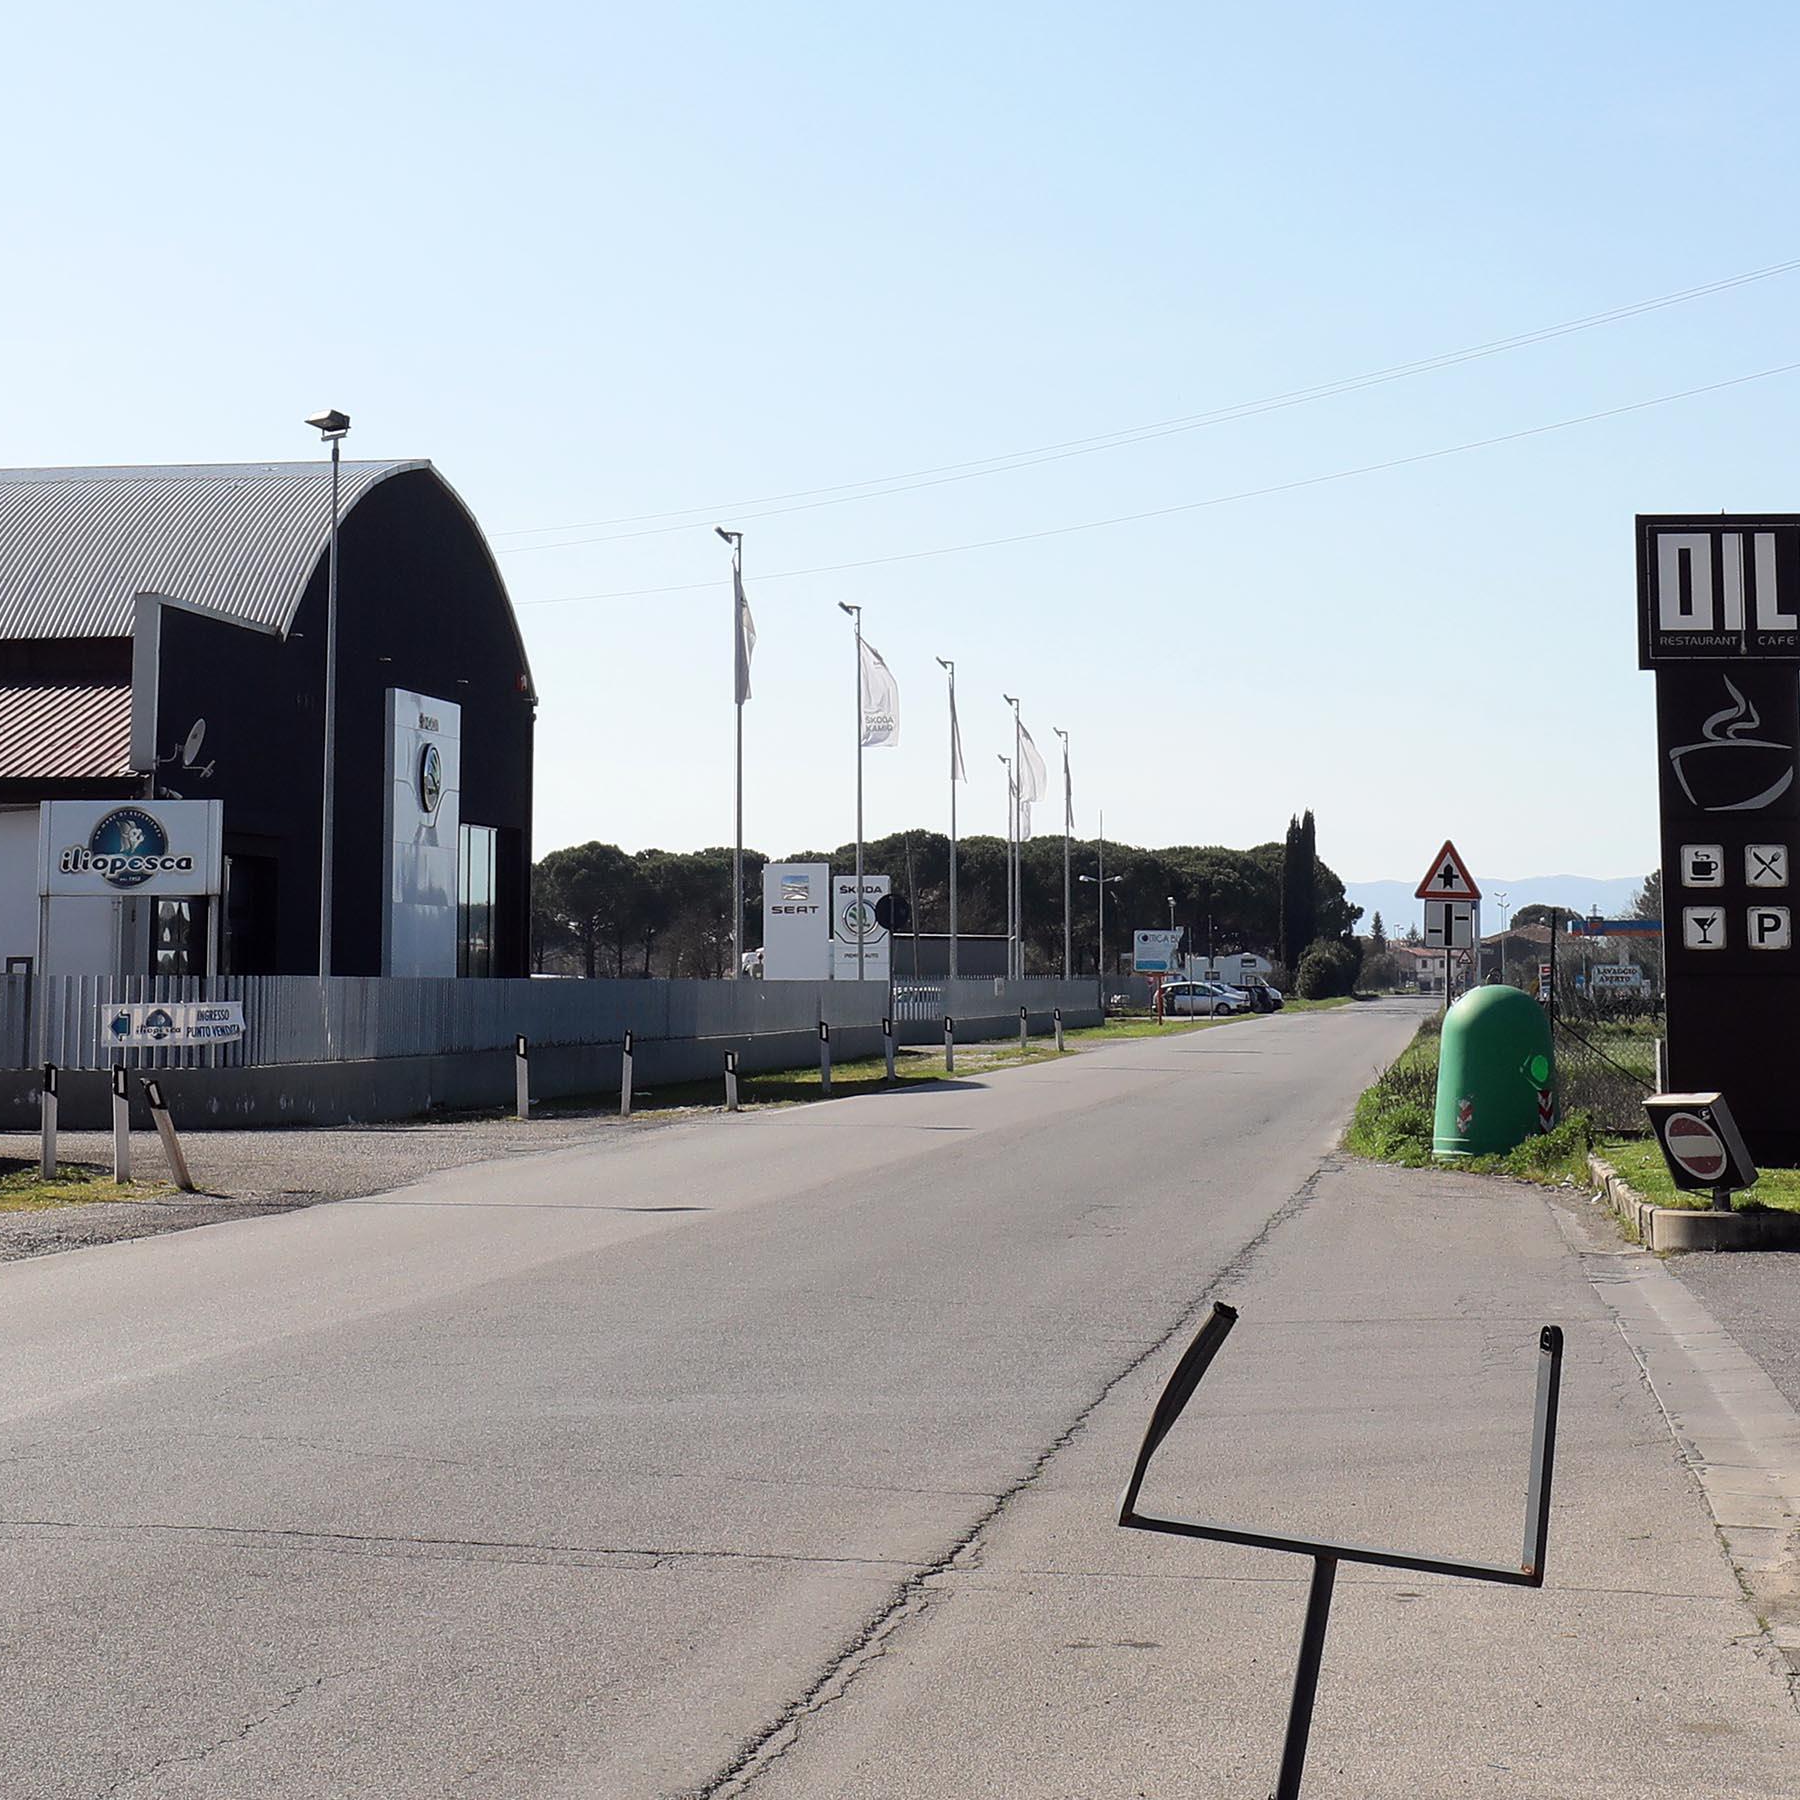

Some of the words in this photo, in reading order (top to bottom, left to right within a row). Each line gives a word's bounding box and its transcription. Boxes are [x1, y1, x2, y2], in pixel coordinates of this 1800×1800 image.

[1657, 533, 1798, 630] OIL
[1659, 636, 1738, 646] RESTAURANT
[61, 847, 194, 875] iliopesca
[771, 905, 820, 914] SEAT
[1758, 913, 1781, 943] P
[197, 1008, 230, 1021] INGRESSO
[186, 1025, 211, 1038] PUNTO
